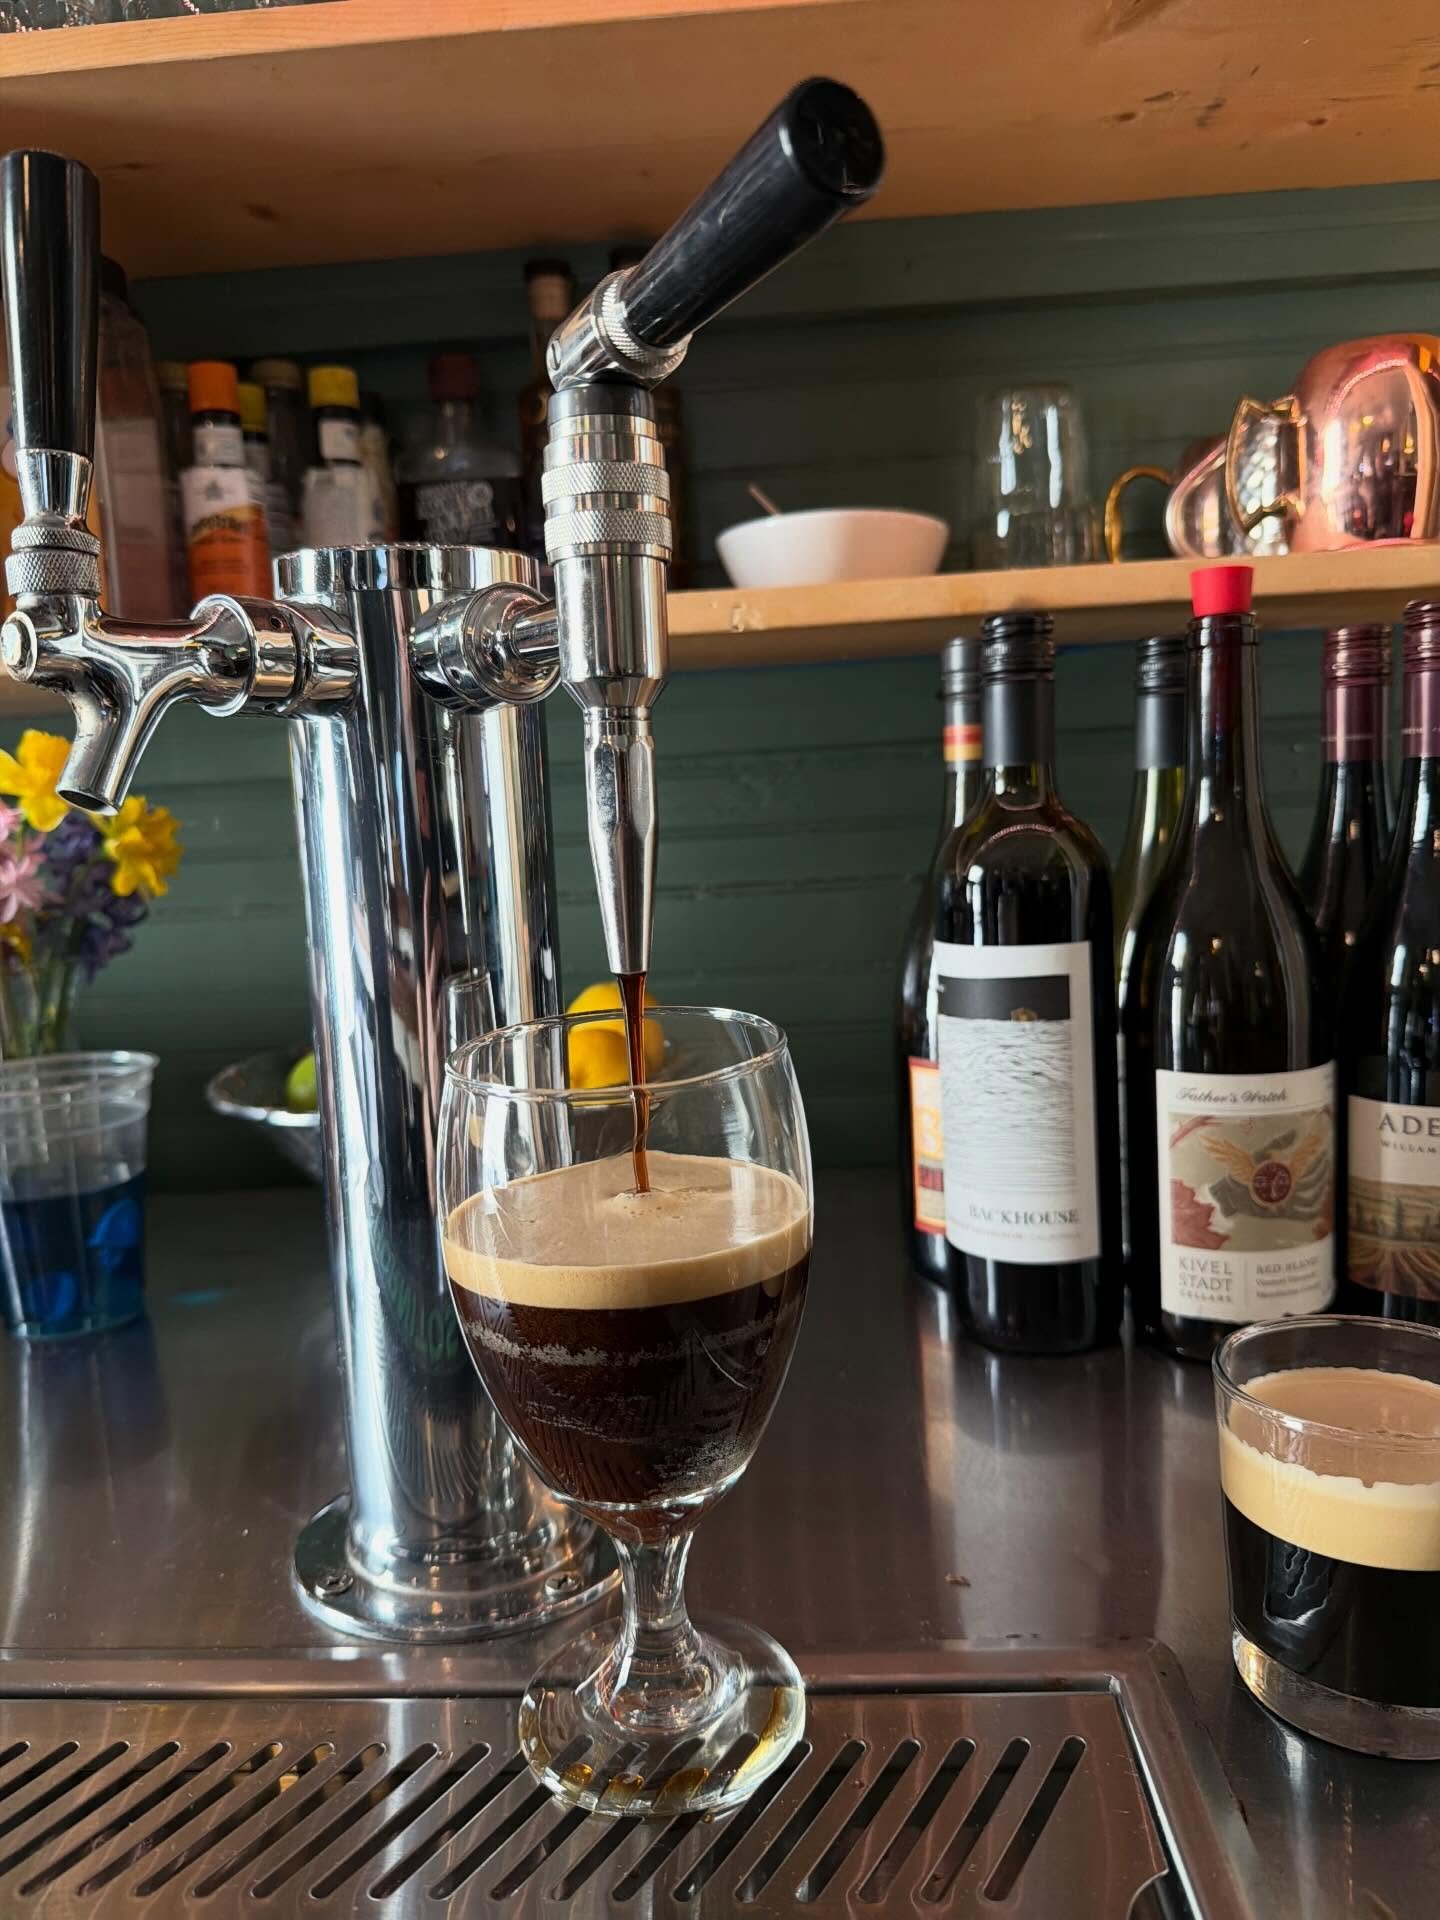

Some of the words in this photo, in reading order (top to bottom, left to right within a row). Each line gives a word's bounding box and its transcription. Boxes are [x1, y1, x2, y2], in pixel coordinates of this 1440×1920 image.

[1176, 1087, 1237, 1103] Father's
[1379, 1112, 1440, 1137] ADE
[968, 1202, 1080, 1226] BACKHOUSE
[1178, 1256, 1232, 1275] KIVEL
[1178, 1272, 1232, 1292] STADT
[1179, 1288, 1232, 1303] CELLARS
